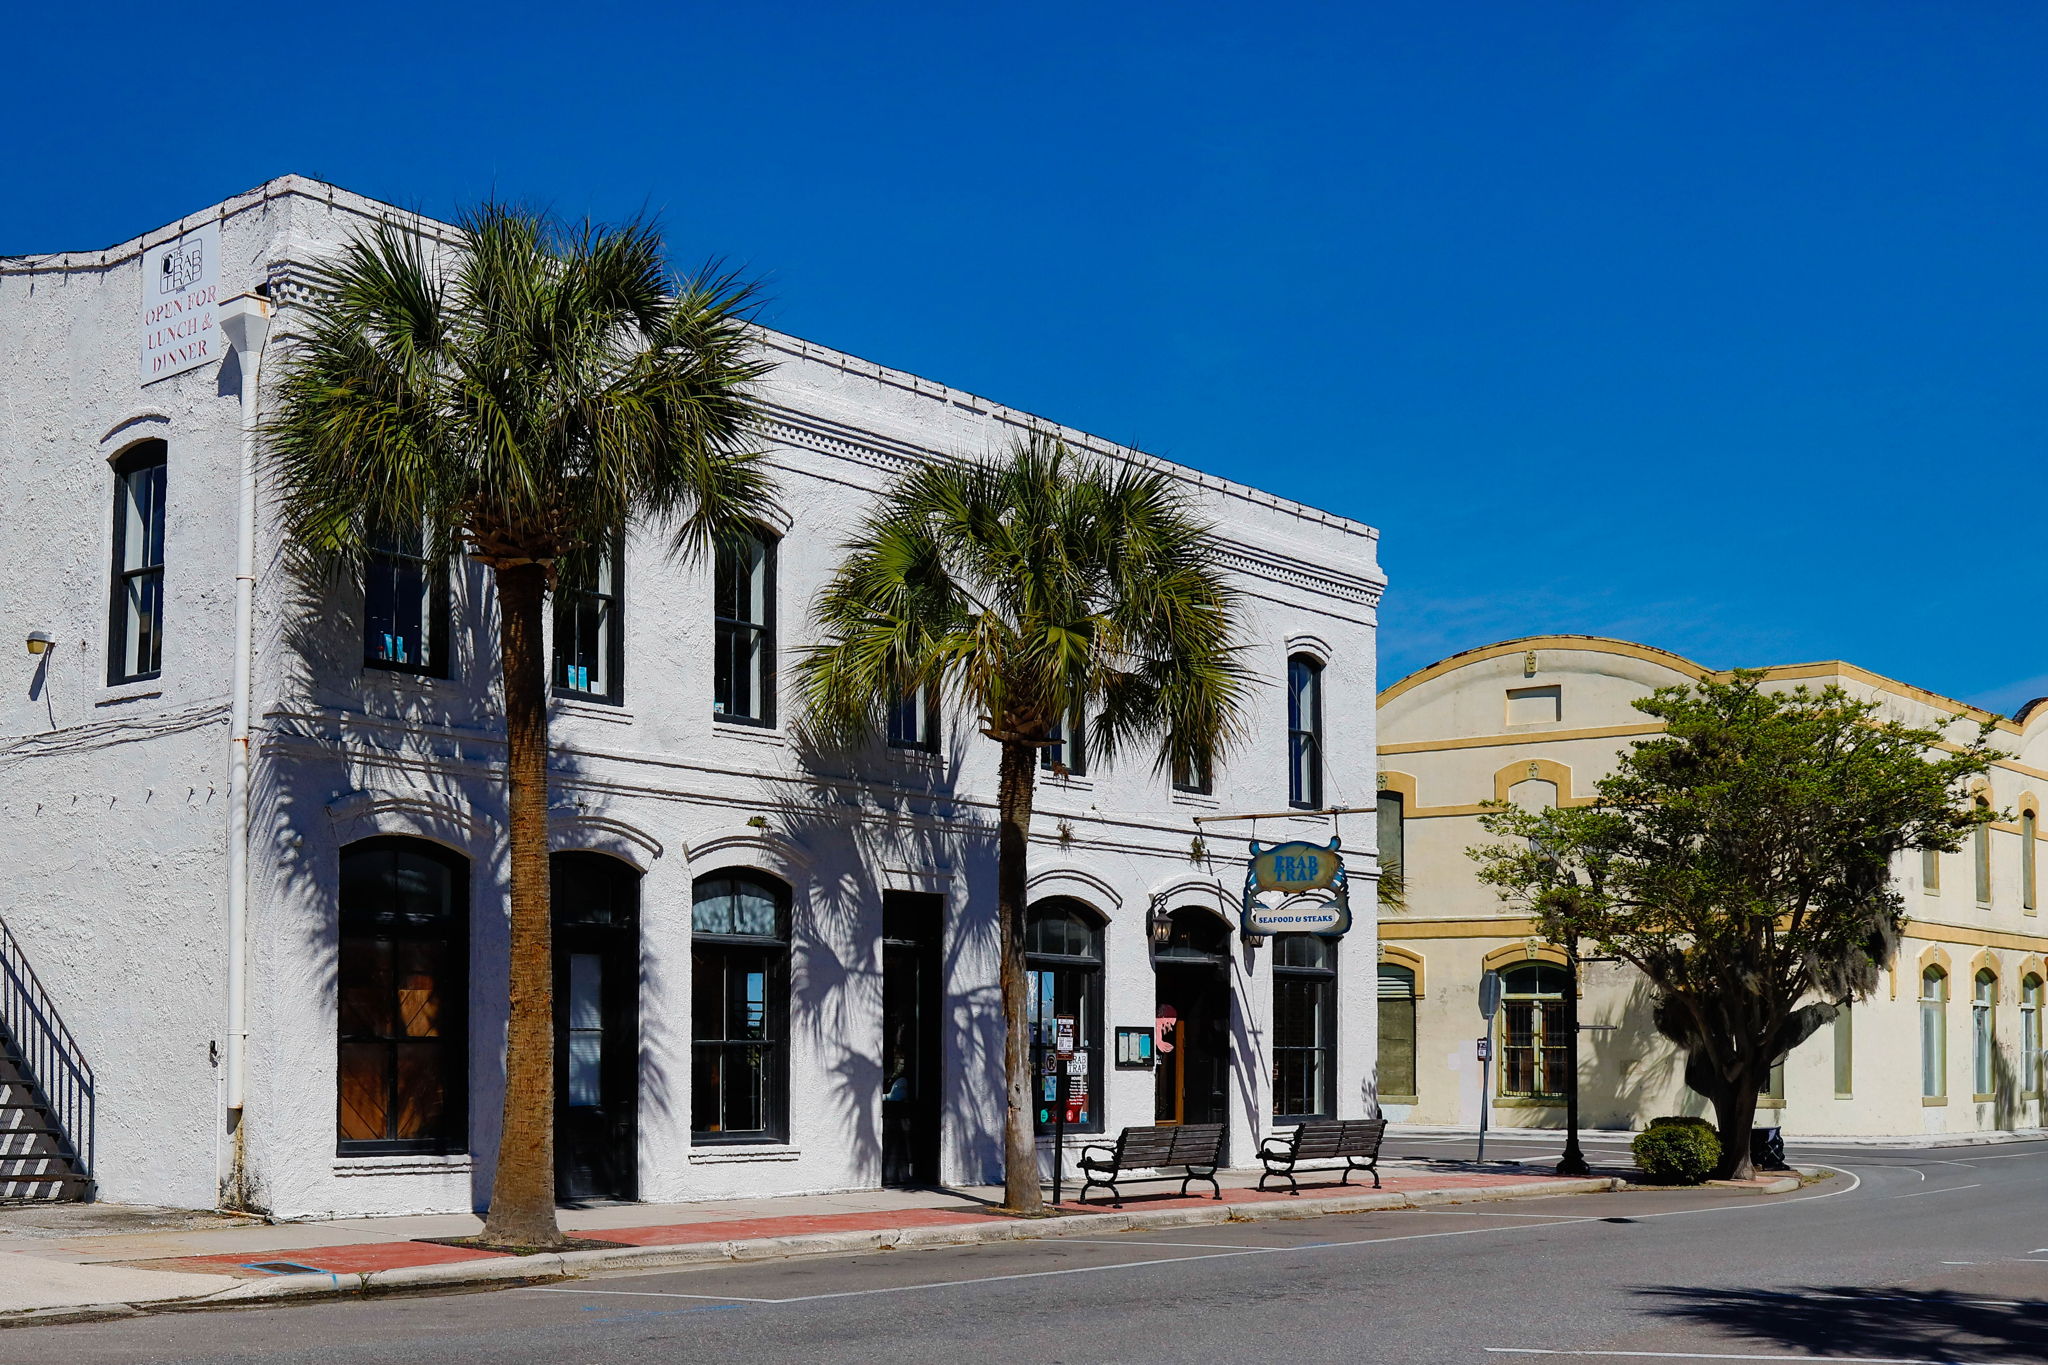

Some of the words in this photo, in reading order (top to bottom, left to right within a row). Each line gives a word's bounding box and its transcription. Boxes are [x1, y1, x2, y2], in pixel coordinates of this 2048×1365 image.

[163, 264, 201, 291] TRAP
[145, 297, 183, 326] OPEN
[187, 285, 217, 311] FOR
[148, 317, 197, 350] LUNCH
[201, 312, 212, 331] &
[153, 340, 207, 373] DINNER
[1275, 867, 1319, 882] TRAP
[1258, 916, 1294, 924] SEAFOOD
[1303, 915, 1333, 923] STEAKS
[1067, 1064, 1087, 1073] TRAP
